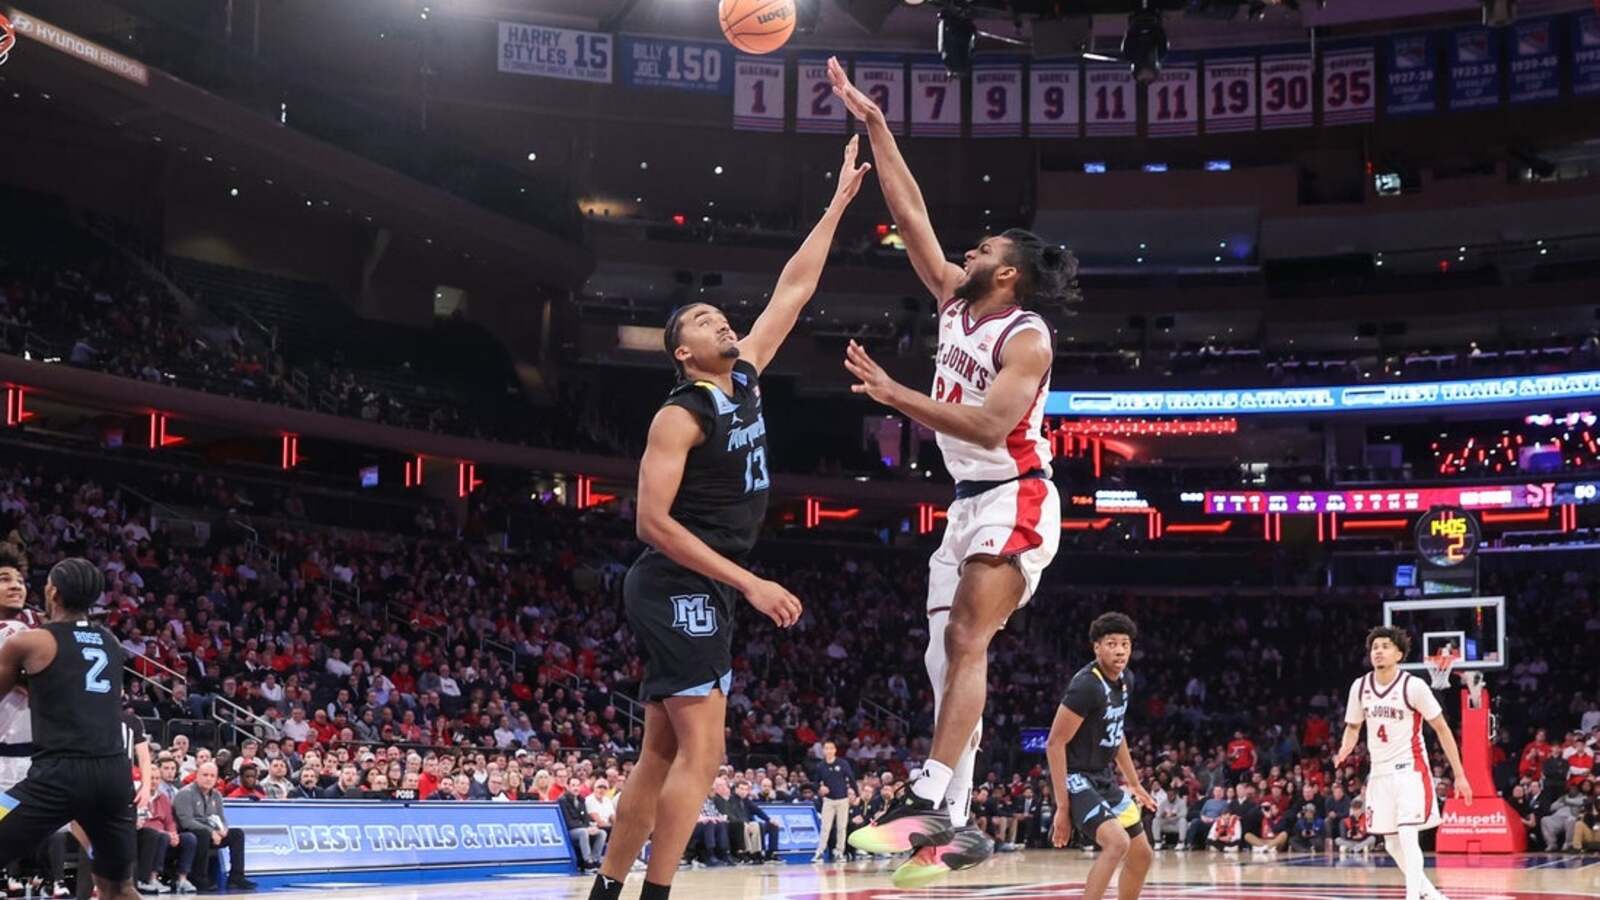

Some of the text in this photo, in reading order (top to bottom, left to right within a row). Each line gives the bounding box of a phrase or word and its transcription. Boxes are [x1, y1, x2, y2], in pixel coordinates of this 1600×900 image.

[508, 26, 561, 47] HARRY
[574, 34, 608, 69] 15
[100, 52, 145, 78] BRIDGE
[503, 43, 567, 66] STYLES
[634, 61, 661, 77] JOEL
[667, 46, 721, 82] 150
[751, 79, 767, 114] 1
[811, 82, 833, 116] 2
[925, 86, 946, 120] 7
[986, 85, 1007, 120] 9
[1043, 86, 1064, 120] 9
[1095, 86, 1126, 120] 11
[1157, 84, 1188, 119] 11
[1212, 79, 1250, 115] 19
[1266, 76, 1309, 111] 30
[1327, 71, 1371, 107] 35
[943, 345, 989, 391] JOHN'S
[1166, 392, 1238, 409] TRAILS
[1256, 389, 1334, 407] TRAVEL
[1441, 383, 1517, 401] TRAILS
[744, 446, 770, 493] 13
[1431, 518, 1467, 536] 14:05
[1447, 533, 1465, 559] 2
[670, 594, 718, 637] MU
[73, 631, 104, 645] ROSS
[82, 647, 111, 693] 2
[1371, 705, 1404, 720] JOHN'S
[1377, 724, 1388, 742] 4
[1442, 812, 1506, 828] Maspeth
[291, 823, 564, 852] BEST TRAILS & TRAVEL
